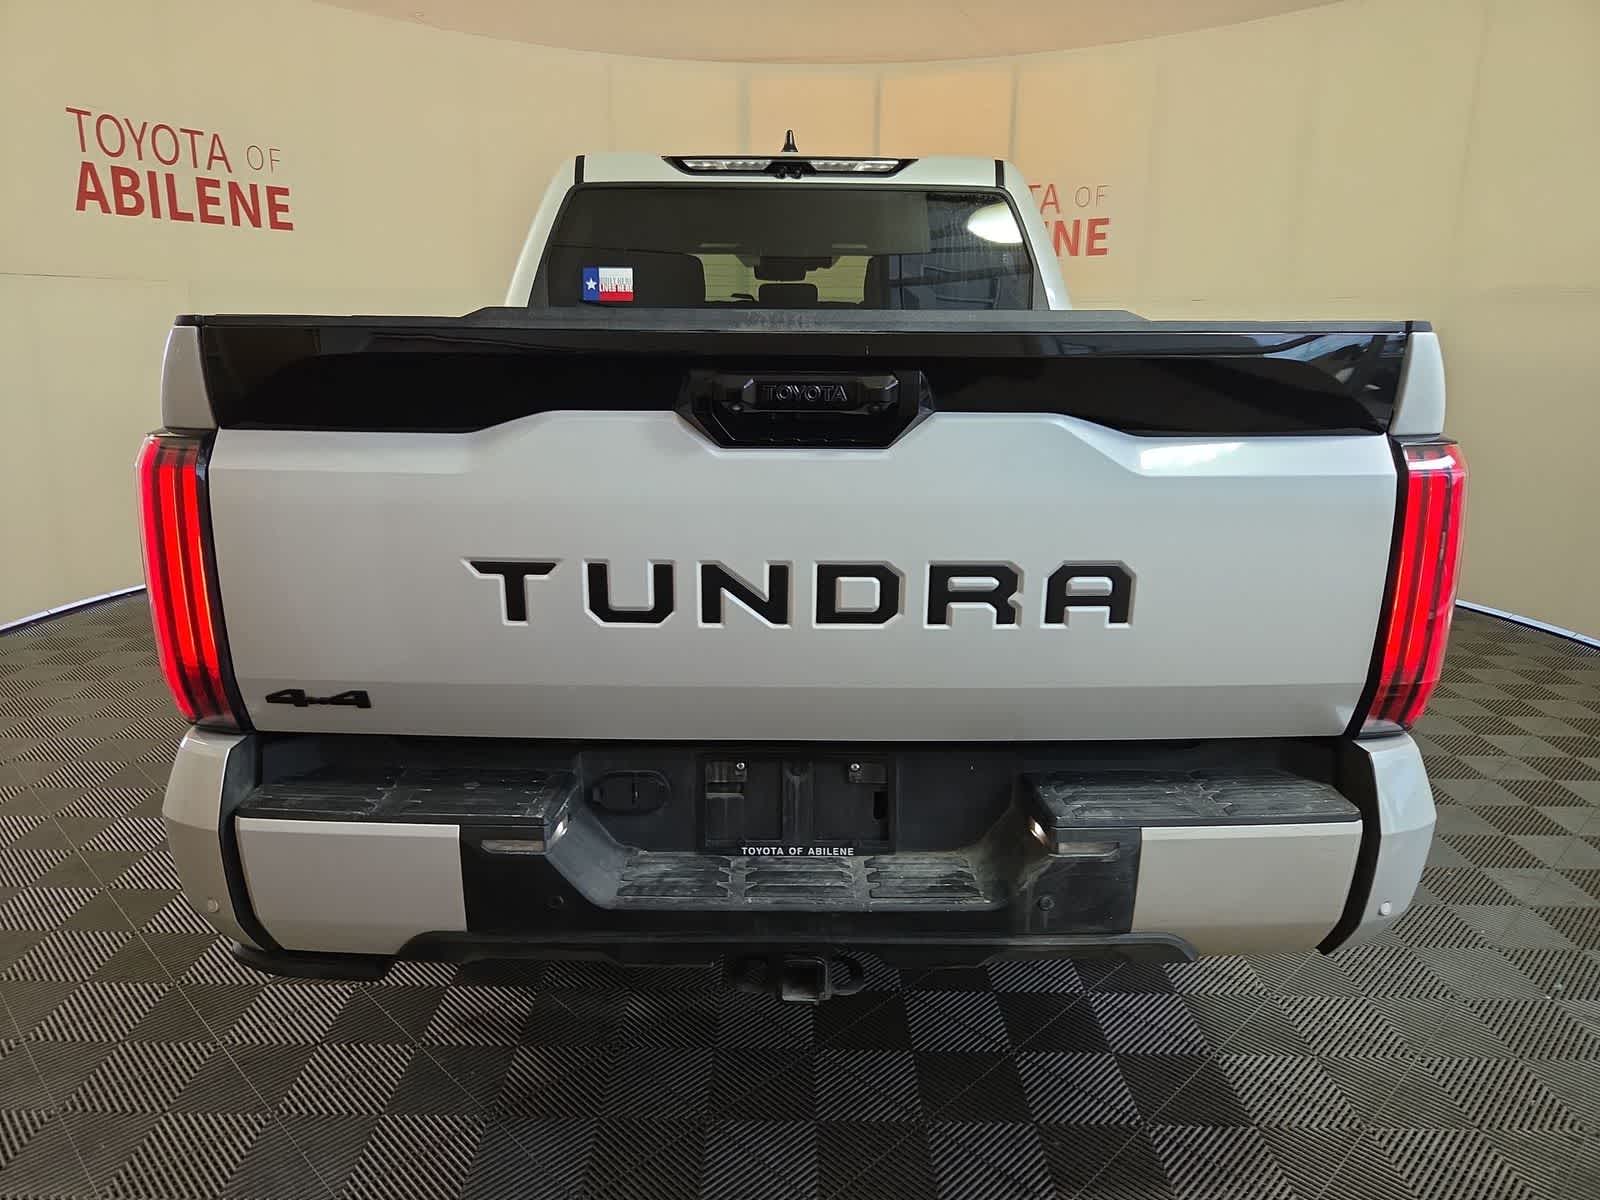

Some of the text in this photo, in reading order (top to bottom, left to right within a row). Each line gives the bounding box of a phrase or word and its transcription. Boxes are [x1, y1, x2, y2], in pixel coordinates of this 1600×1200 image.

[65, 106, 281, 174] TOYOTA OF
[75, 160, 294, 231] ABILENE
[1074, 184, 1110, 209] OF
[763, 384, 848, 401] TOYOTA
[463, 559, 1136, 628] TUNDRA
[741, 846, 855, 856] TOYOTA OF ABILENE
